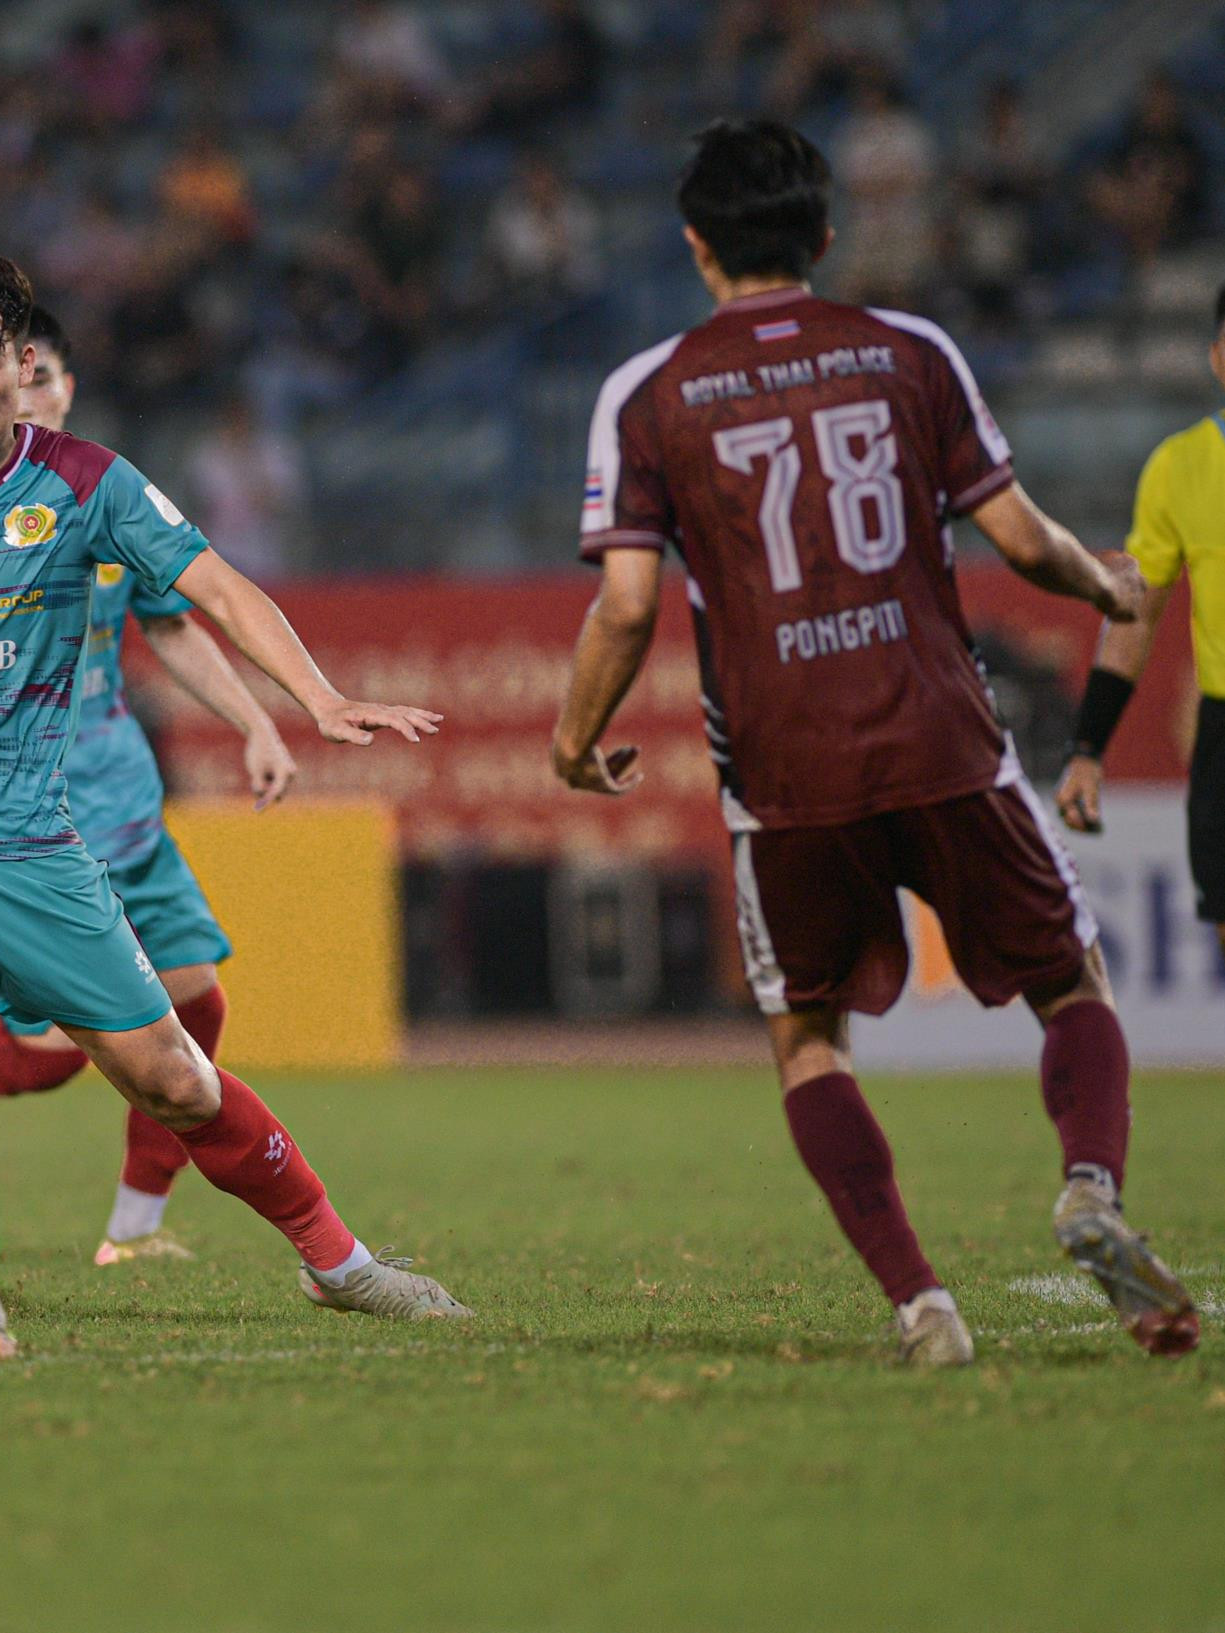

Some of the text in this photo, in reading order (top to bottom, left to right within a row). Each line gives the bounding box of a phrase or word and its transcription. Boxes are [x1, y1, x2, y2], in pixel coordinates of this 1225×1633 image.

[680, 346, 897, 407] ROYAL THAI POLICE
[712, 399, 906, 593] 78
